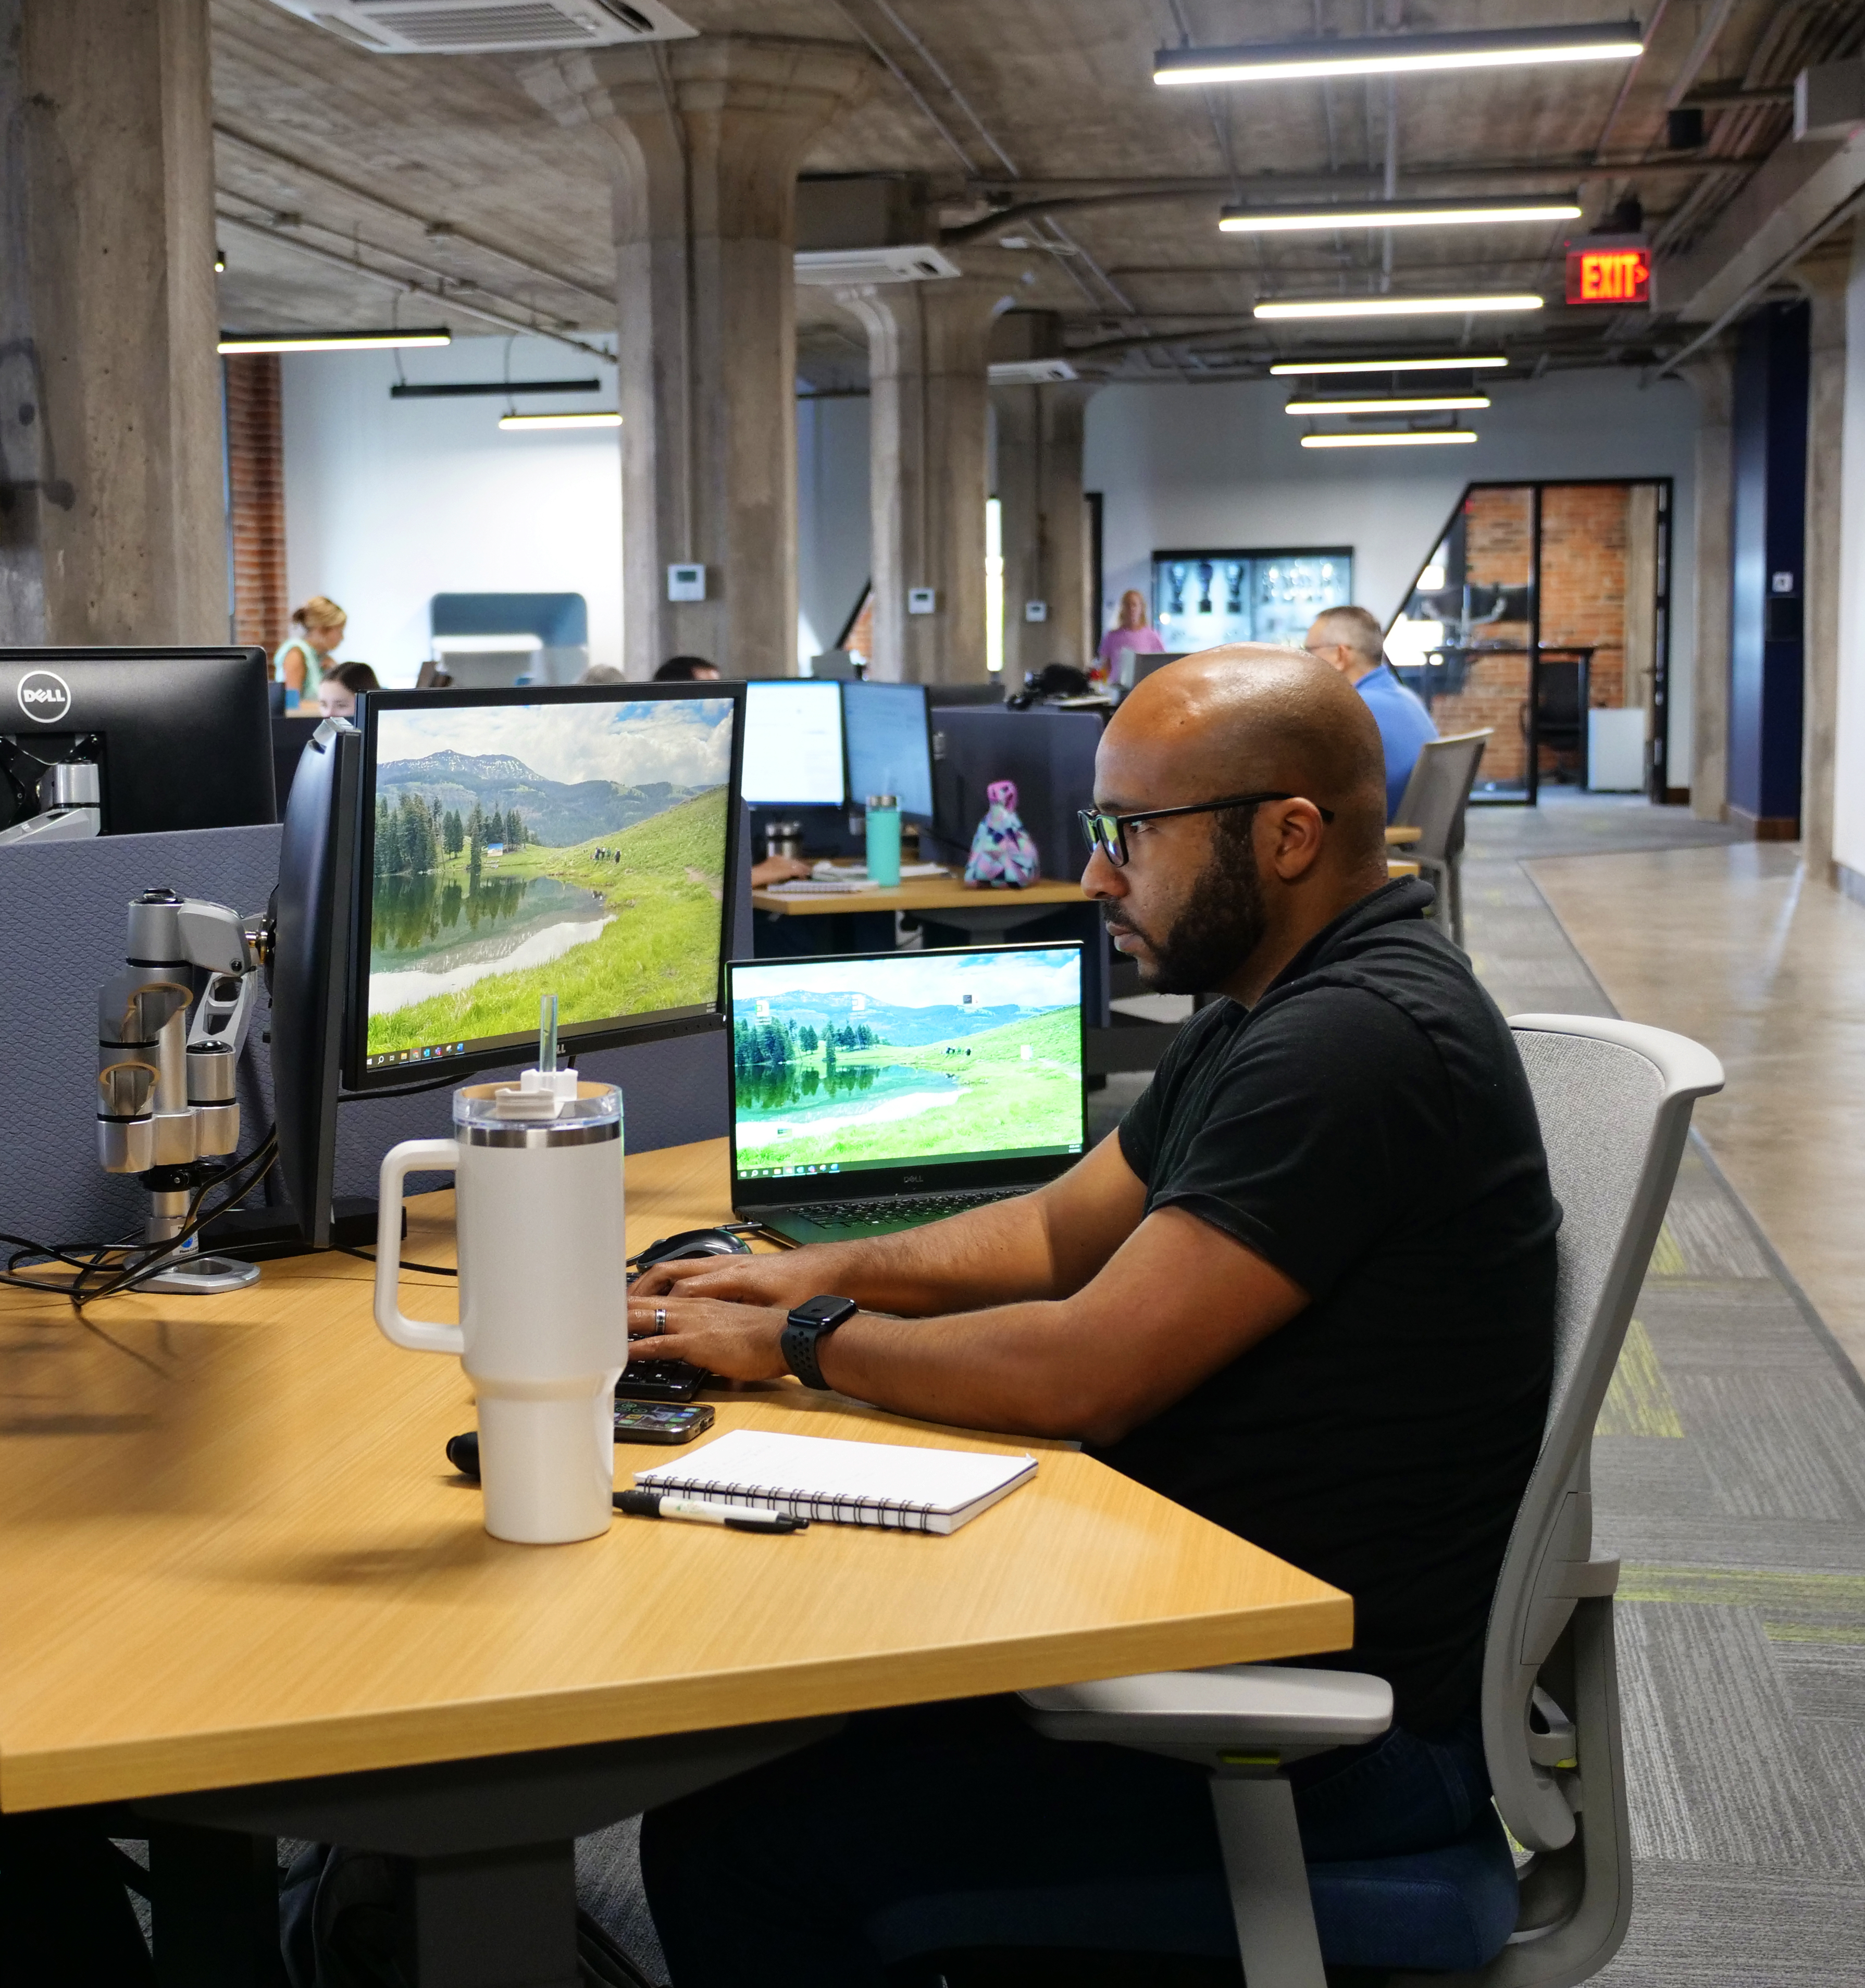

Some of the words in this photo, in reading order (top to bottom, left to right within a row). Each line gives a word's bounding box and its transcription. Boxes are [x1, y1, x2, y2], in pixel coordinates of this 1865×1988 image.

[1582, 253, 1639, 299] EXIT
[23, 689, 66, 703] DELL
[903, 1175, 924, 1183] DELL
